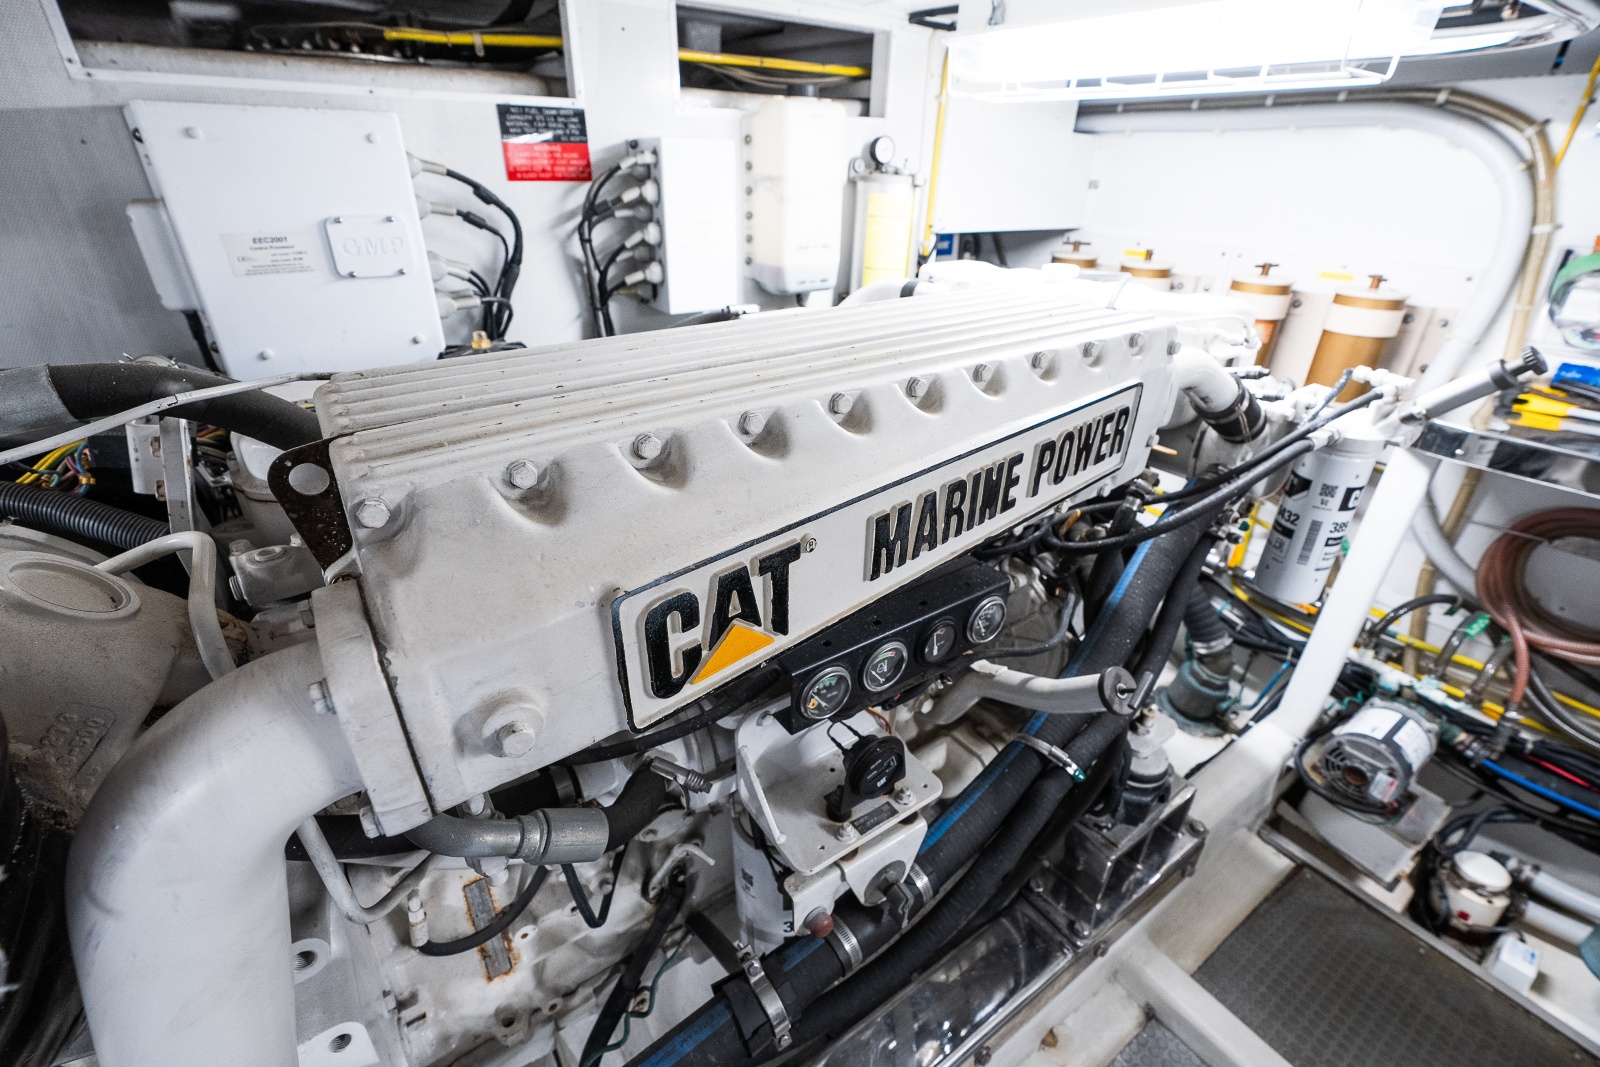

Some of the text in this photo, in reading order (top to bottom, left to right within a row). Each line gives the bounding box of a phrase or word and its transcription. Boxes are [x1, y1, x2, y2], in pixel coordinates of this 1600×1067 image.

[252, 236, 288, 244] EEC2001
[340, 236, 404, 257] GMP
[868, 404, 1131, 582] MARINE POWER
[643, 540, 802, 700] CAT
